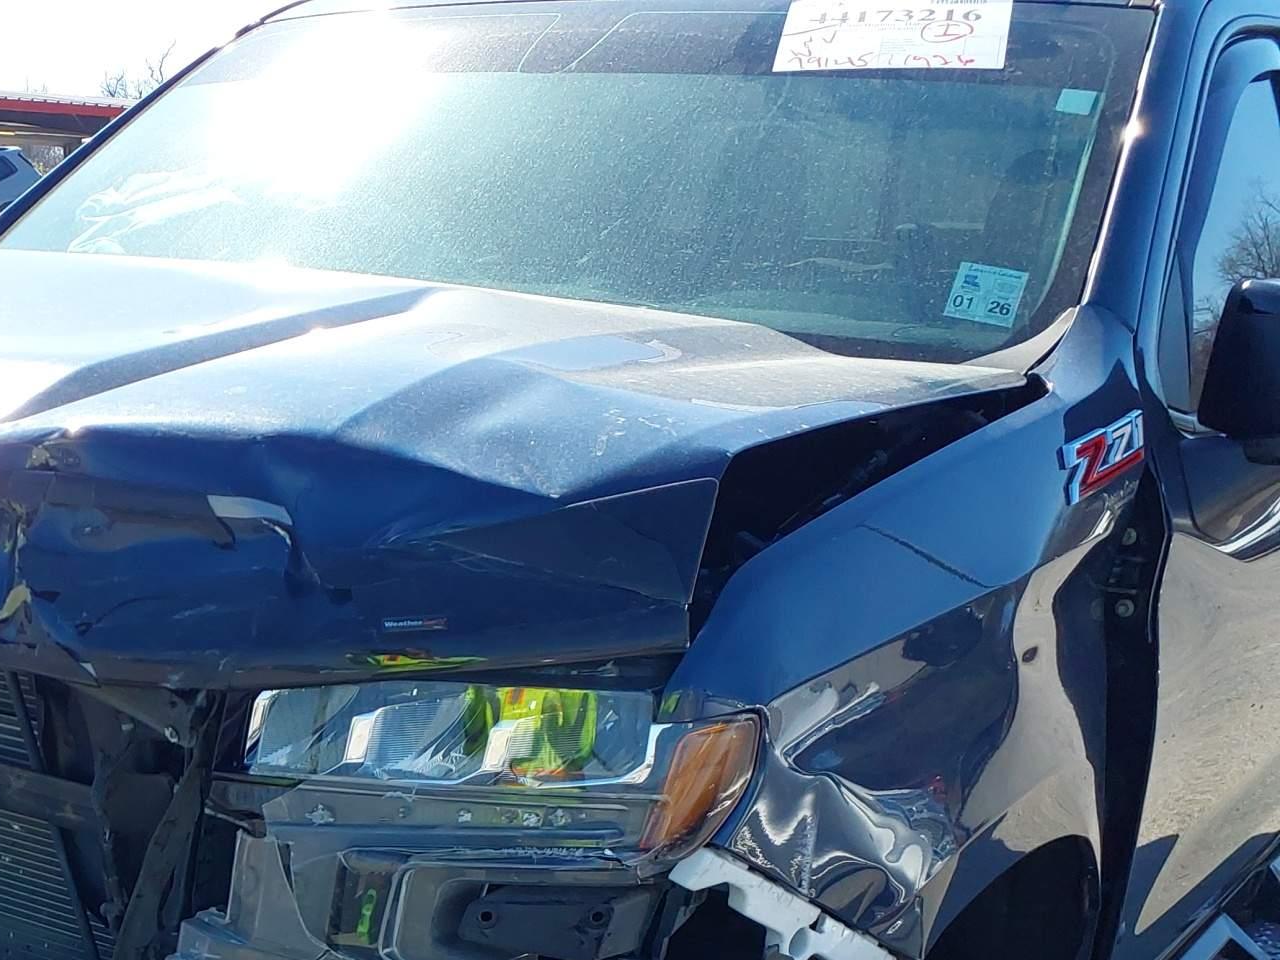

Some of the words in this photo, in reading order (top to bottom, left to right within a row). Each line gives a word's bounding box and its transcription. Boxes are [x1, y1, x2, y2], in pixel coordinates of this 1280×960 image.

[952, 294, 975, 310] 01
[987, 300, 1013, 316] 26
[1058, 408, 1145, 506] Z71
